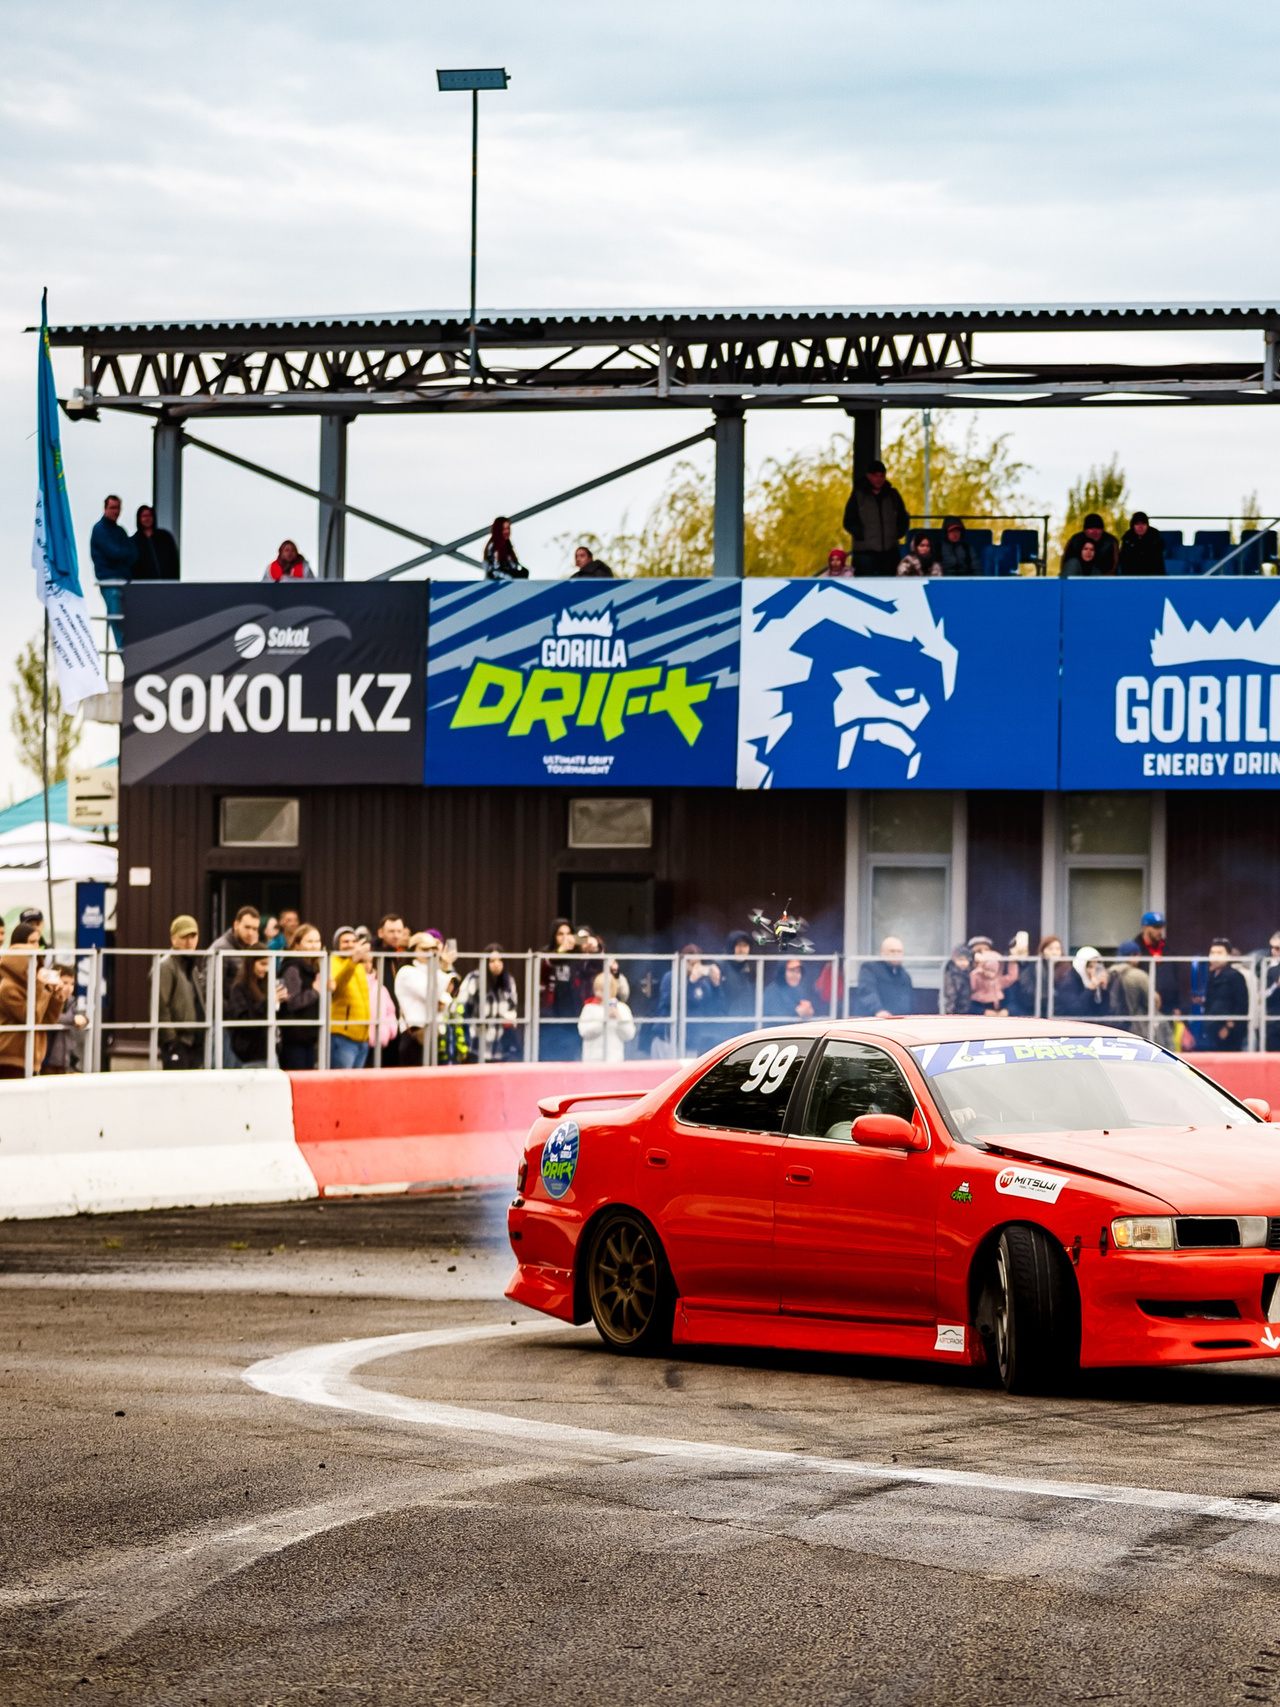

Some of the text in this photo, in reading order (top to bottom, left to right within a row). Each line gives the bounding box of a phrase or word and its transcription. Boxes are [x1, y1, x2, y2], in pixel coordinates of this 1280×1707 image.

[541, 638, 627, 668] GORILLA
[132, 673, 412, 734] SOKOL.KZ
[542, 755, 615, 766] ULTIMATE DRIFT
[546, 765, 611, 775] TOURNAMENT
[1143, 753, 1229, 777] ENERGY
[740, 1043, 799, 1095] 99
[1014, 1176, 1058, 1191] MITSUJI
